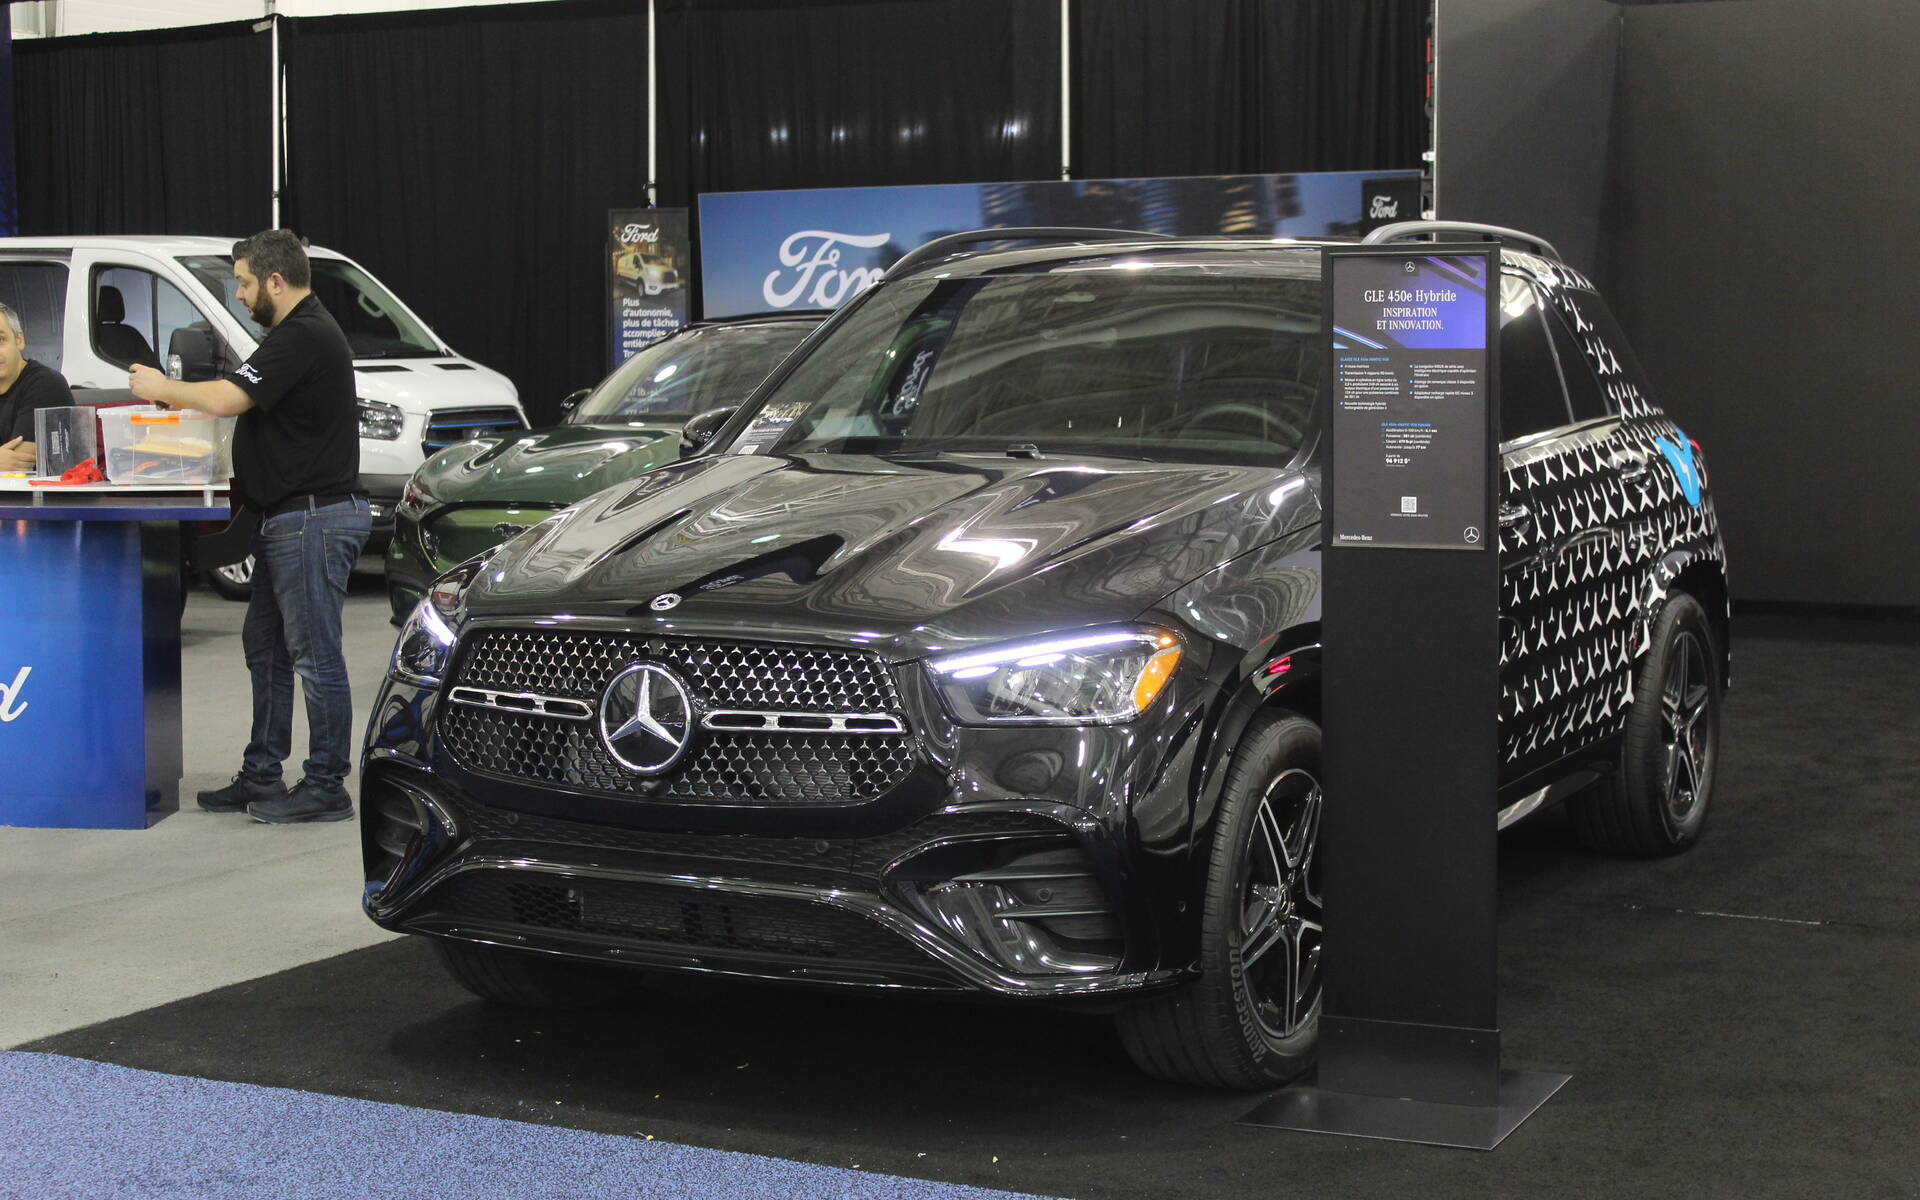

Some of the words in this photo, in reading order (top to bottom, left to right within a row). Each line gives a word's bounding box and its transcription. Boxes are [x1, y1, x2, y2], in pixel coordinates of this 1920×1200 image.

[1370, 195, 1398, 219] Ford
[620, 223, 659, 243] Ford
[763, 230, 890, 308] For
[622, 297, 640, 307] Plus
[1364, 290, 1385, 302] GLE
[1387, 290, 1412, 302] 450e
[1416, 290, 1457, 305] Hybride
[622, 307, 673, 318] d'autonomie,
[1383, 307, 1438, 317] INSPIRATION
[622, 318, 640, 329] plus
[641, 318, 652, 327] de
[653, 318, 680, 327] tâches
[1376, 319, 1386, 330] ET
[1389, 319, 1444, 331] INNOVATION.
[235, 363, 263, 384] Ford
